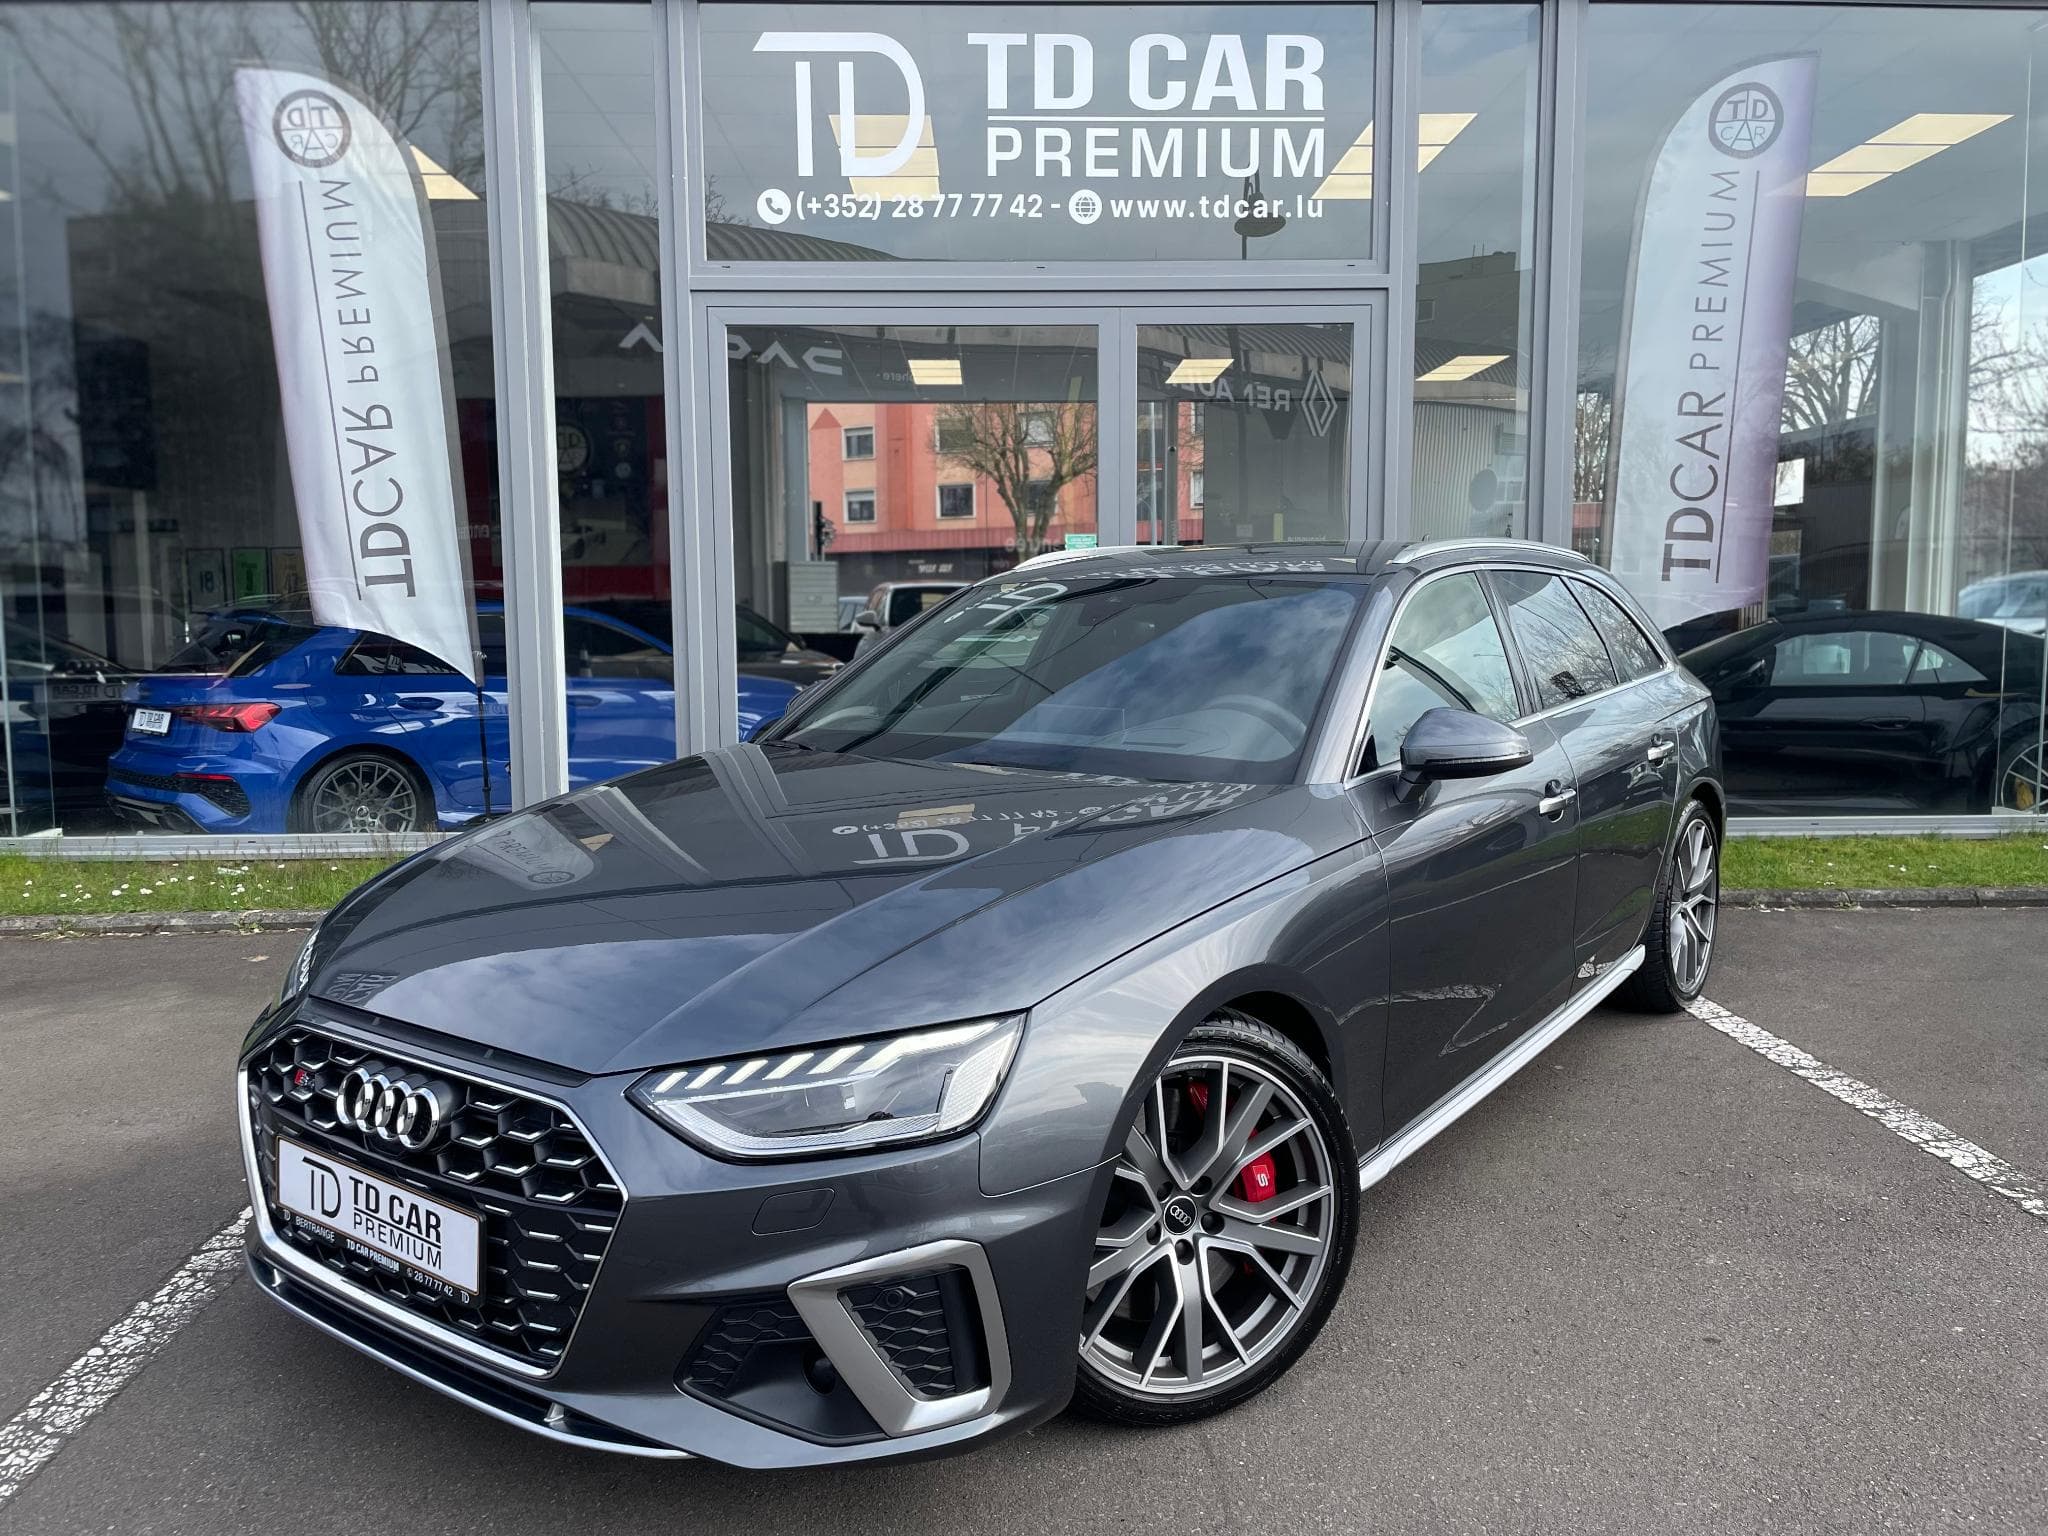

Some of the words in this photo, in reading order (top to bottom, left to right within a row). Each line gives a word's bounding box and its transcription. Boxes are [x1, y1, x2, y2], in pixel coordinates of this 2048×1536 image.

[967, 33, 1094, 110] TD
[1129, 34, 1325, 111] CAR
[1726, 98, 1769, 120] TD
[987, 127, 1325, 178] PREMIUM
[796, 191, 881, 221] (+352)
[891, 194, 924, 218] 28
[931, 194, 963, 218] 77
[970, 194, 1003, 218] 77
[1009, 194, 1043, 218] 42
[1111, 194, 1324, 219] www.tdcar.lu
[1690, 170, 1741, 371] PREMIUM
[1661, 390, 1727, 583] TDCAR
[295, 1216, 335, 1241] BERTRANGE
[349, 1175, 380, 1214] TD
[389, 1194, 442, 1244] CAR
[346, 1239, 355, 1250] TD
[356, 1243, 369, 1257] CAR
[369, 1248, 400, 1273] PREMIUM
[353, 1212, 442, 1270] PREMIUM
[414, 1271, 424, 1283] 28
[424, 1275, 433, 1287] 77
[434, 1280, 443, 1291] 77
[443, 1284, 454, 1297] 42
